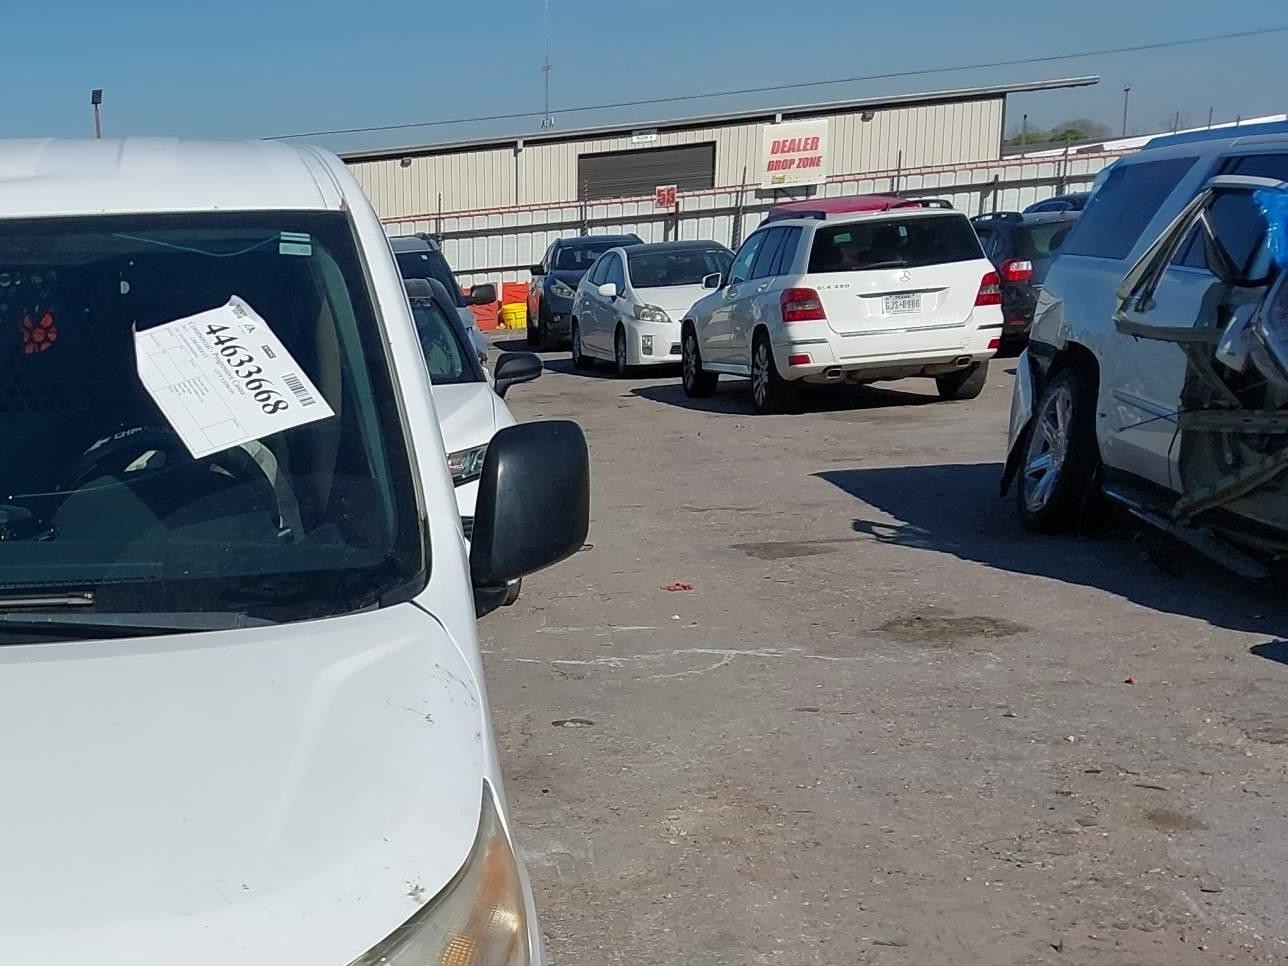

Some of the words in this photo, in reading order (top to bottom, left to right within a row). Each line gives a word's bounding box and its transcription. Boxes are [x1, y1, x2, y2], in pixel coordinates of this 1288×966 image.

[770, 137, 820, 154] DEALER
[767, 159, 795, 172] DROP
[796, 156, 822, 169] ZONE
[206, 323, 289, 415] 44633668
